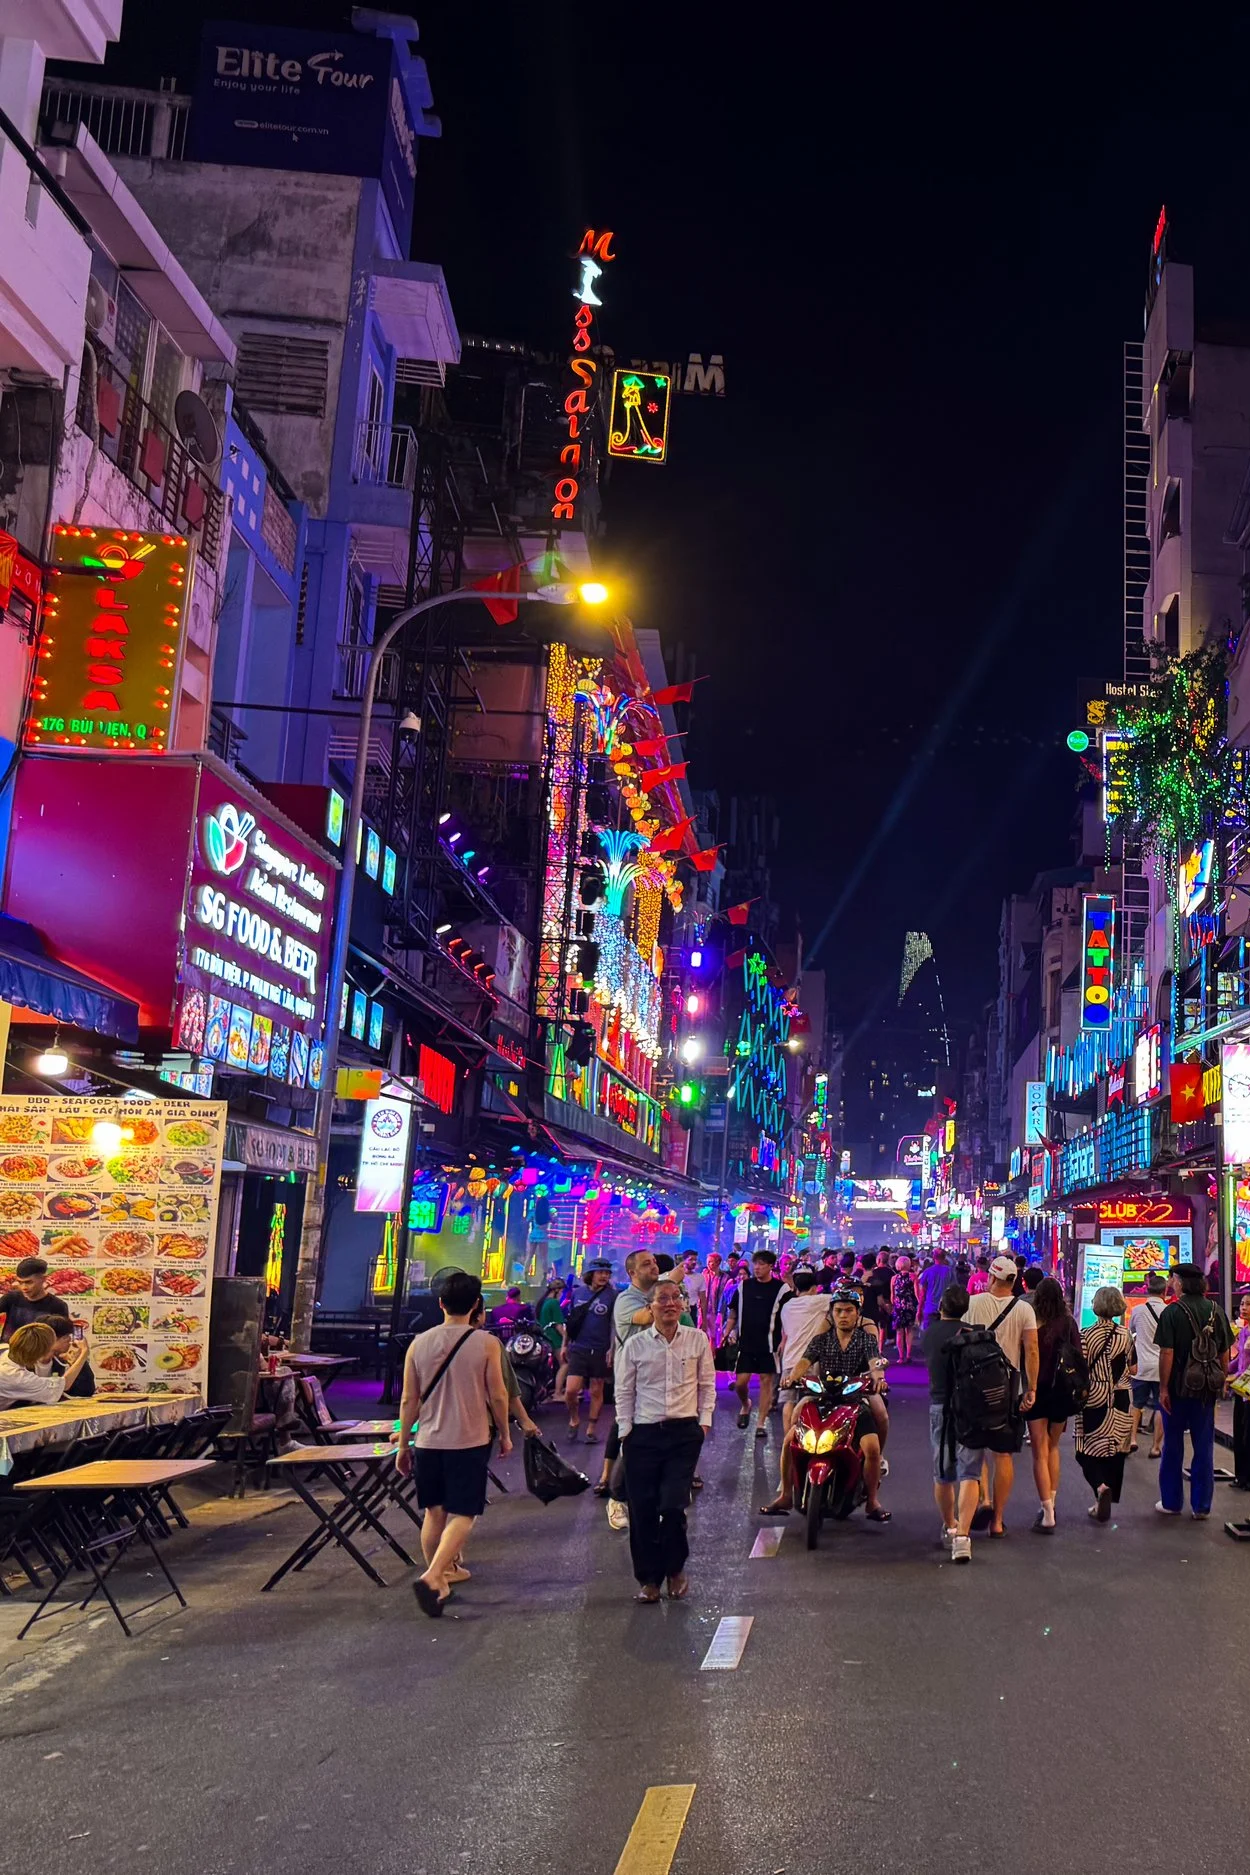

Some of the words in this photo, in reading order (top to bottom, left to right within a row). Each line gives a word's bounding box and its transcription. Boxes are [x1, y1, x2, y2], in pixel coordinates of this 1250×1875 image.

[215, 45, 302, 82] Elite
[307, 49, 374, 89] Tour
[213, 78, 246, 91] Enjoy
[250, 84, 276, 94] your
[280, 84, 301, 95] life
[259, 120, 329, 136] elitetour.com.vn
[1105, 683, 1137, 696] Hostel
[41, 717, 65, 732] 176
[71, 715, 94, 734] BÙI
[200, 885, 224, 932] SG
[227, 900, 271, 955] FOOD
[269, 927, 283, 964] &
[284, 931, 317, 995] BEER
[1085, 911, 1110, 1024] TATTOO
[27, 1096, 50, 1105] BBQ
[62, 1097, 114, 1106] SEAFOOD
[124, 1099, 152, 1107] FOOD
[164, 1100, 190, 1108] BEER
[1099, 1203, 1137, 1218] CLUB
